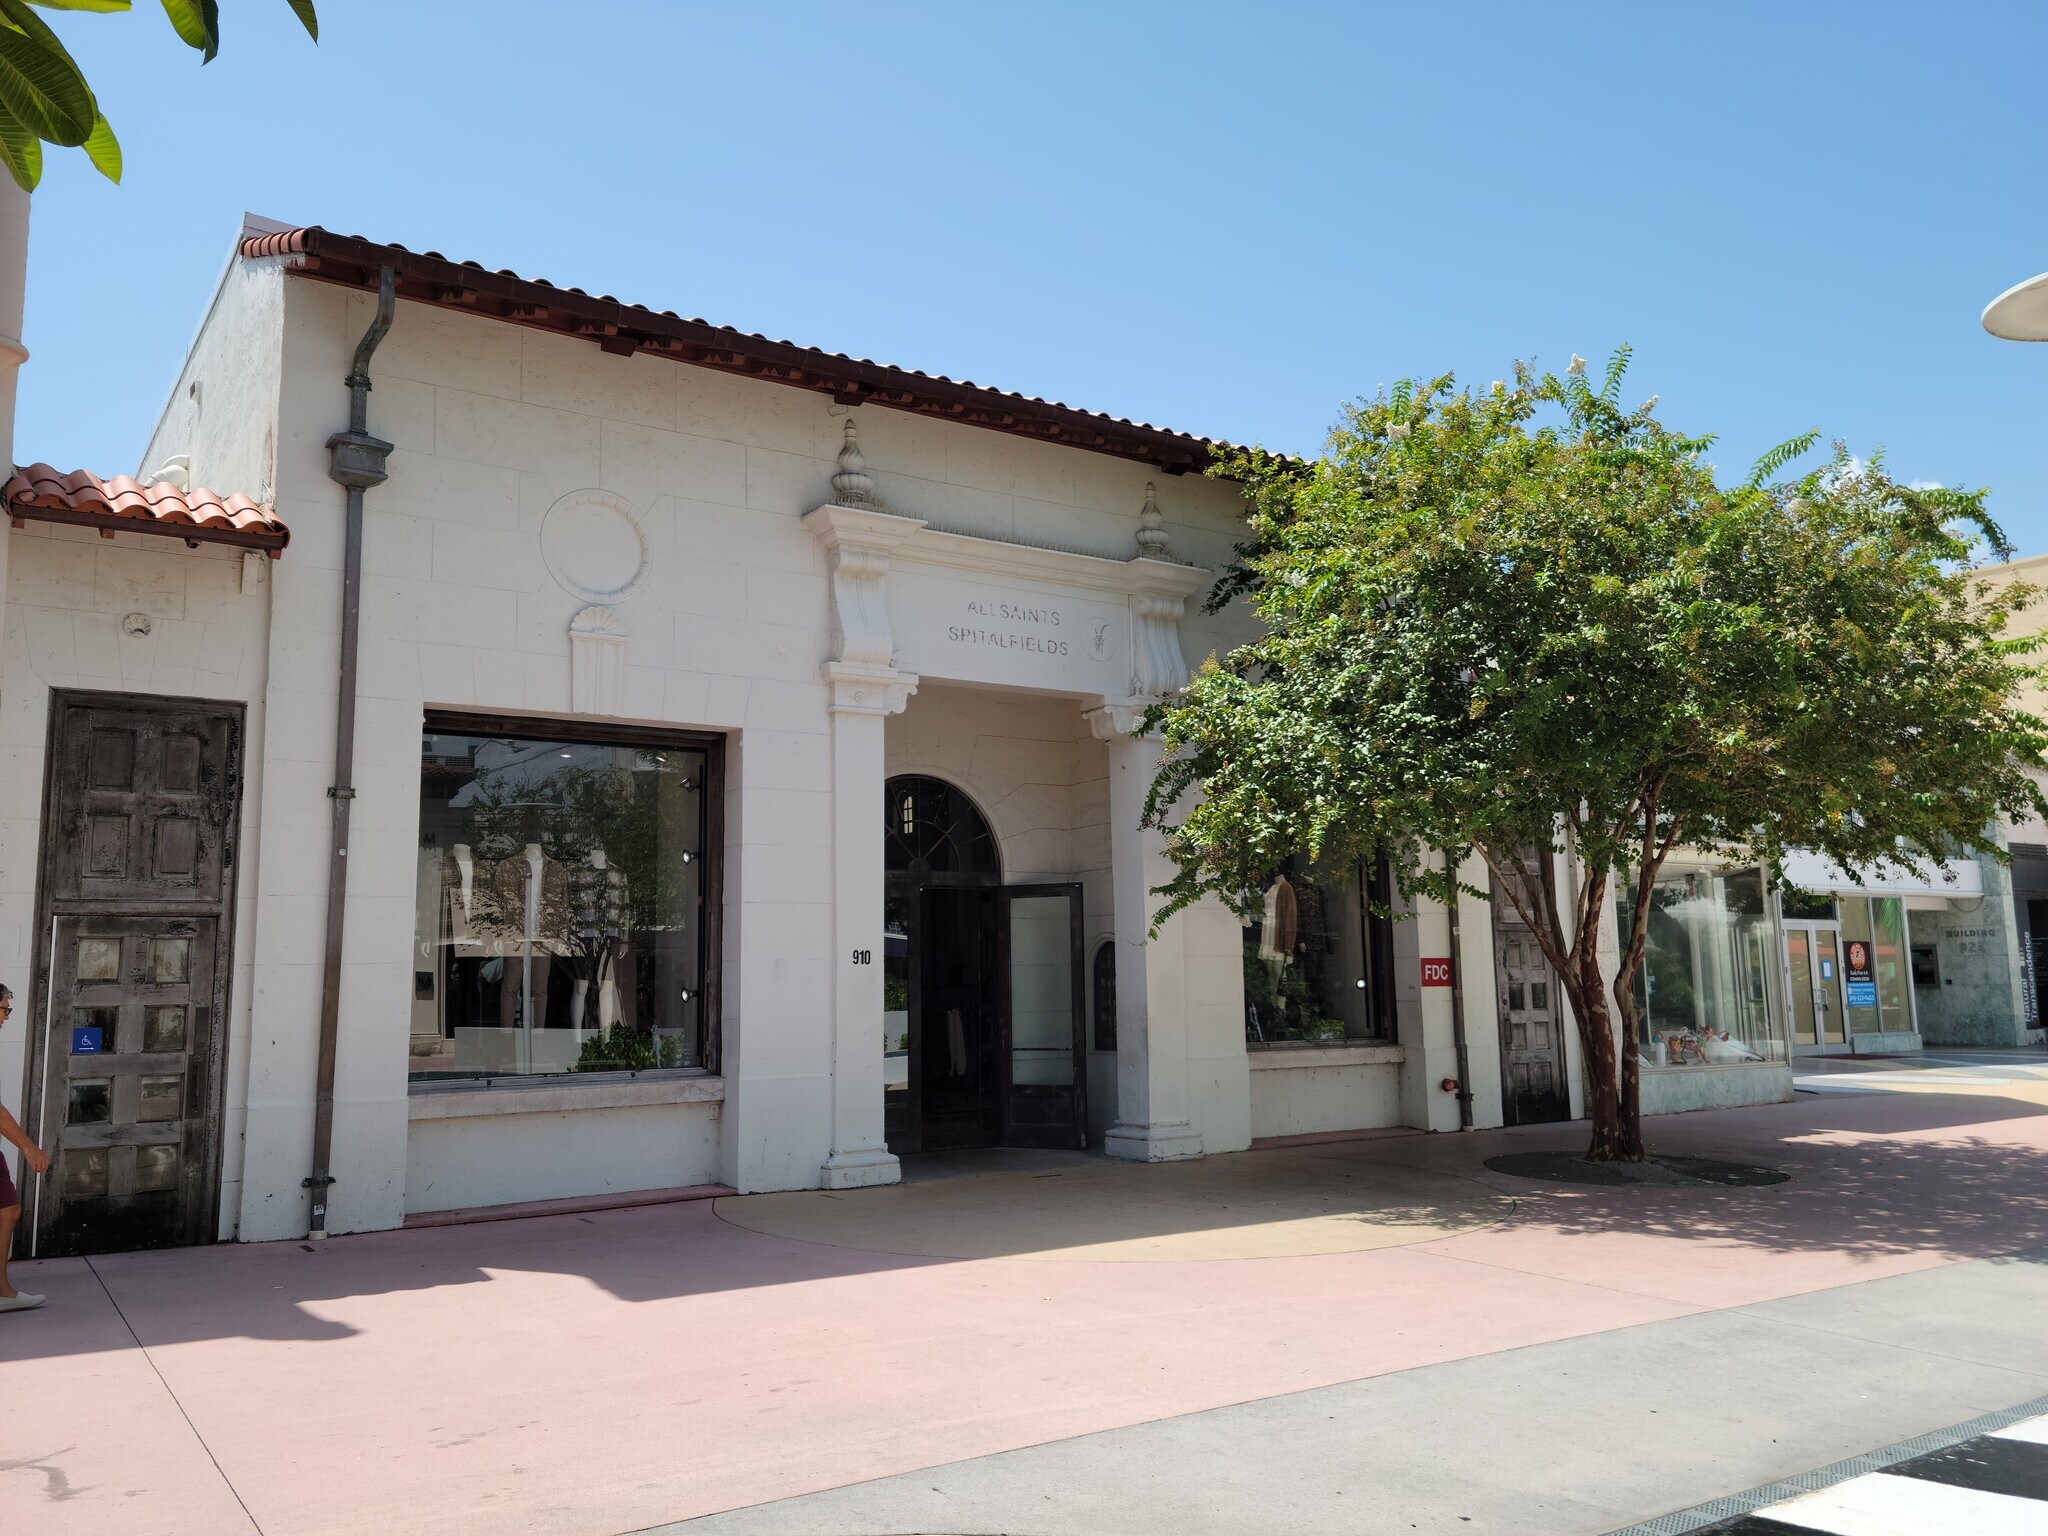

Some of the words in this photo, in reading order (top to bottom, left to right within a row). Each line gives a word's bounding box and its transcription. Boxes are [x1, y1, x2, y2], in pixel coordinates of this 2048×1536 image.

[967, 601, 1061, 626] ALLSAINTS
[948, 626, 1069, 656] SPITALFIELDS
[1946, 929, 1996, 938] BUILDING
[852, 949, 871, 965] 910
[1424, 964, 1449, 980] FDC
[2024, 931, 2038, 1021] Transcendence
[2020, 978, 2031, 1022] Natural
